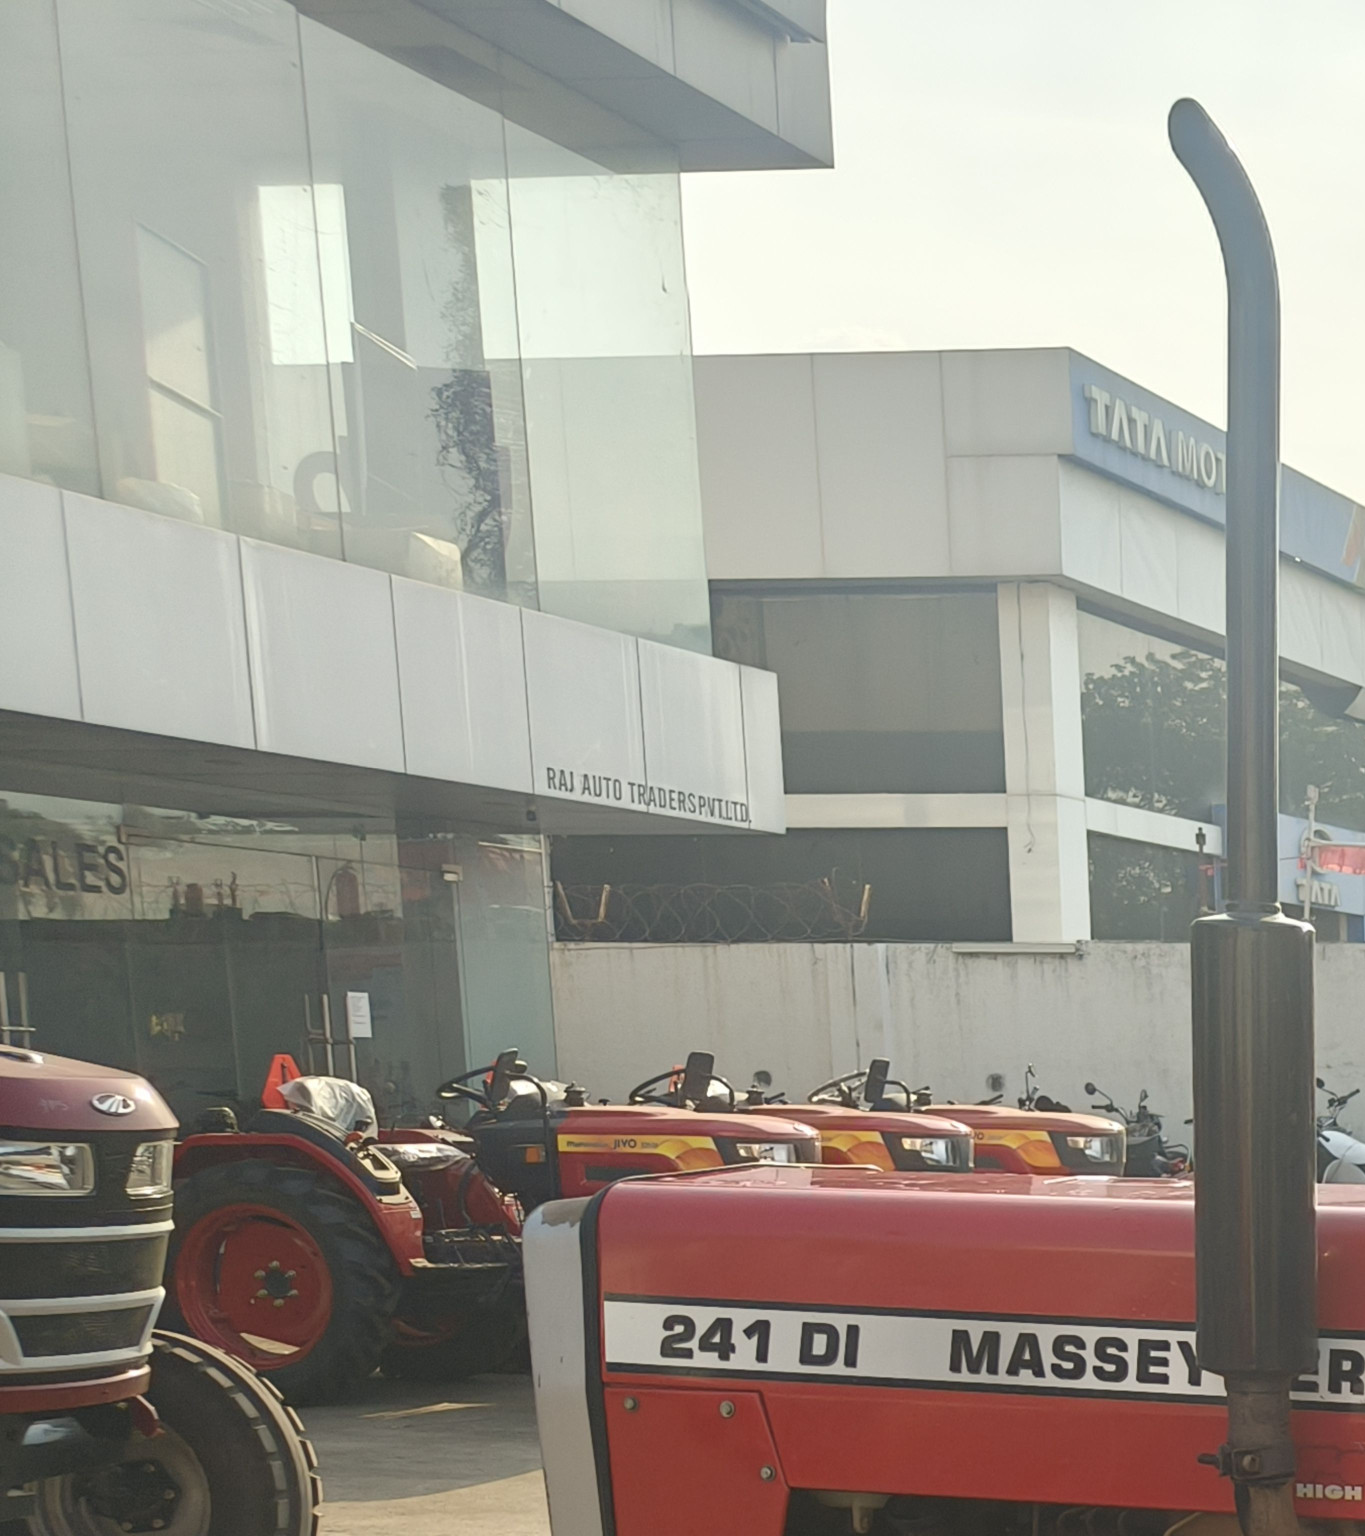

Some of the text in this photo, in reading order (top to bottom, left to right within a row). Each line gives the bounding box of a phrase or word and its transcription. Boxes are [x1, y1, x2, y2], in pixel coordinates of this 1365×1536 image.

[1085, 384, 1170, 468] TATA
[546, 767, 574, 792] RAJ
[581, 773, 622, 801] AUTO
[628, 782, 697, 814] TRADERS
[1296, 878, 1341, 906] TATA
[612, 1138, 638, 1149] JIVO
[660, 1315, 772, 1363] 241
[799, 1322, 860, 1368] DI
[949, 1329, 1202, 1387] MASSEY
[1296, 1483, 1362, 1502] HIGH
